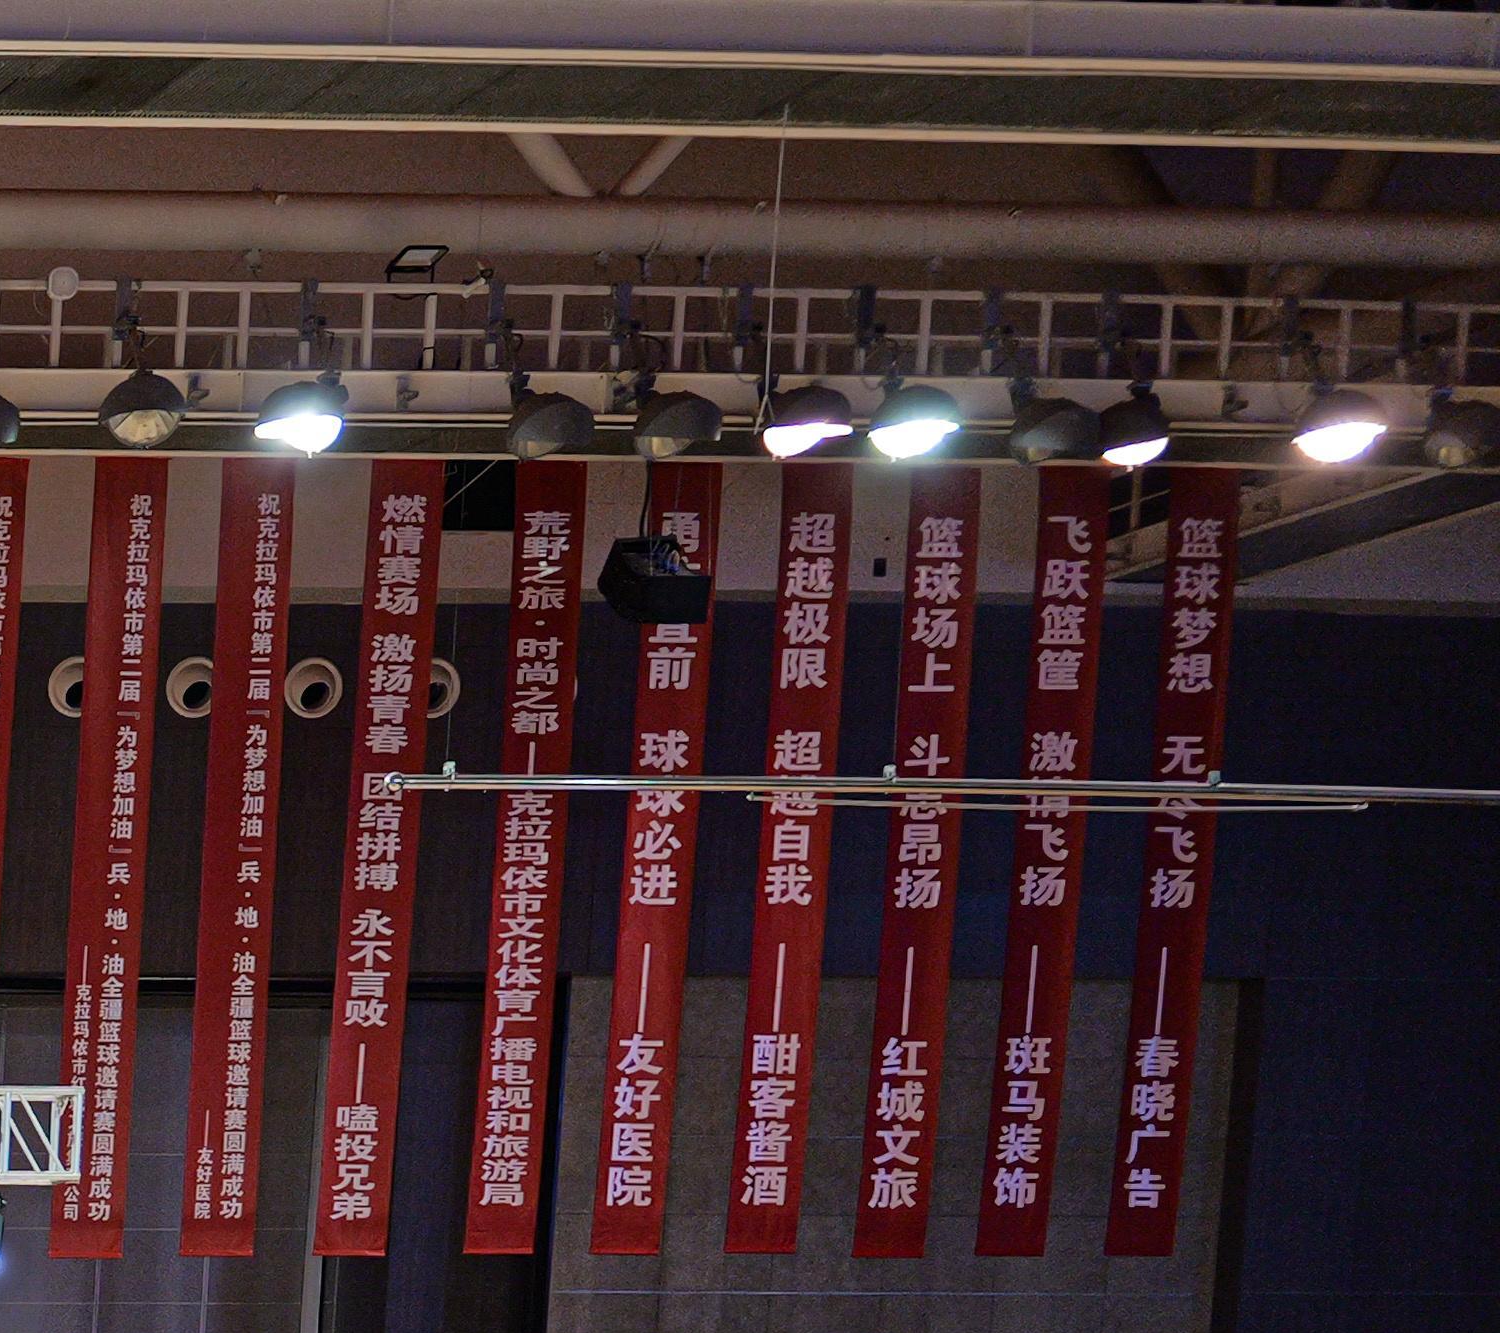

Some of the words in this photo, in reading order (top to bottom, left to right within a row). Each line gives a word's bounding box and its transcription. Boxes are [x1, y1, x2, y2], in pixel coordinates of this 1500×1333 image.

[373, 494, 426, 615] 燃情赛场
[646, 512, 701, 690] 勇前
[778, 512, 836, 690] 超越极限
[908, 516, 963, 693] 篮球场上
[1037, 516, 1092, 692] 飞跃篮筐
[1167, 517, 1223, 694] 篮球梦想
[365, 634, 416, 754] 激扬青春
[354, 772, 404, 892] 团结拼搏
[628, 729, 689, 906] 球球必进
[764, 730, 822, 906] 超越自我
[893, 734, 950, 910] 斗志昂扬
[1019, 732, 1078, 908] 激情飞扬
[1149, 735, 1205, 910] 无尽飞扬
[344, 909, 394, 1027] 永不言败
